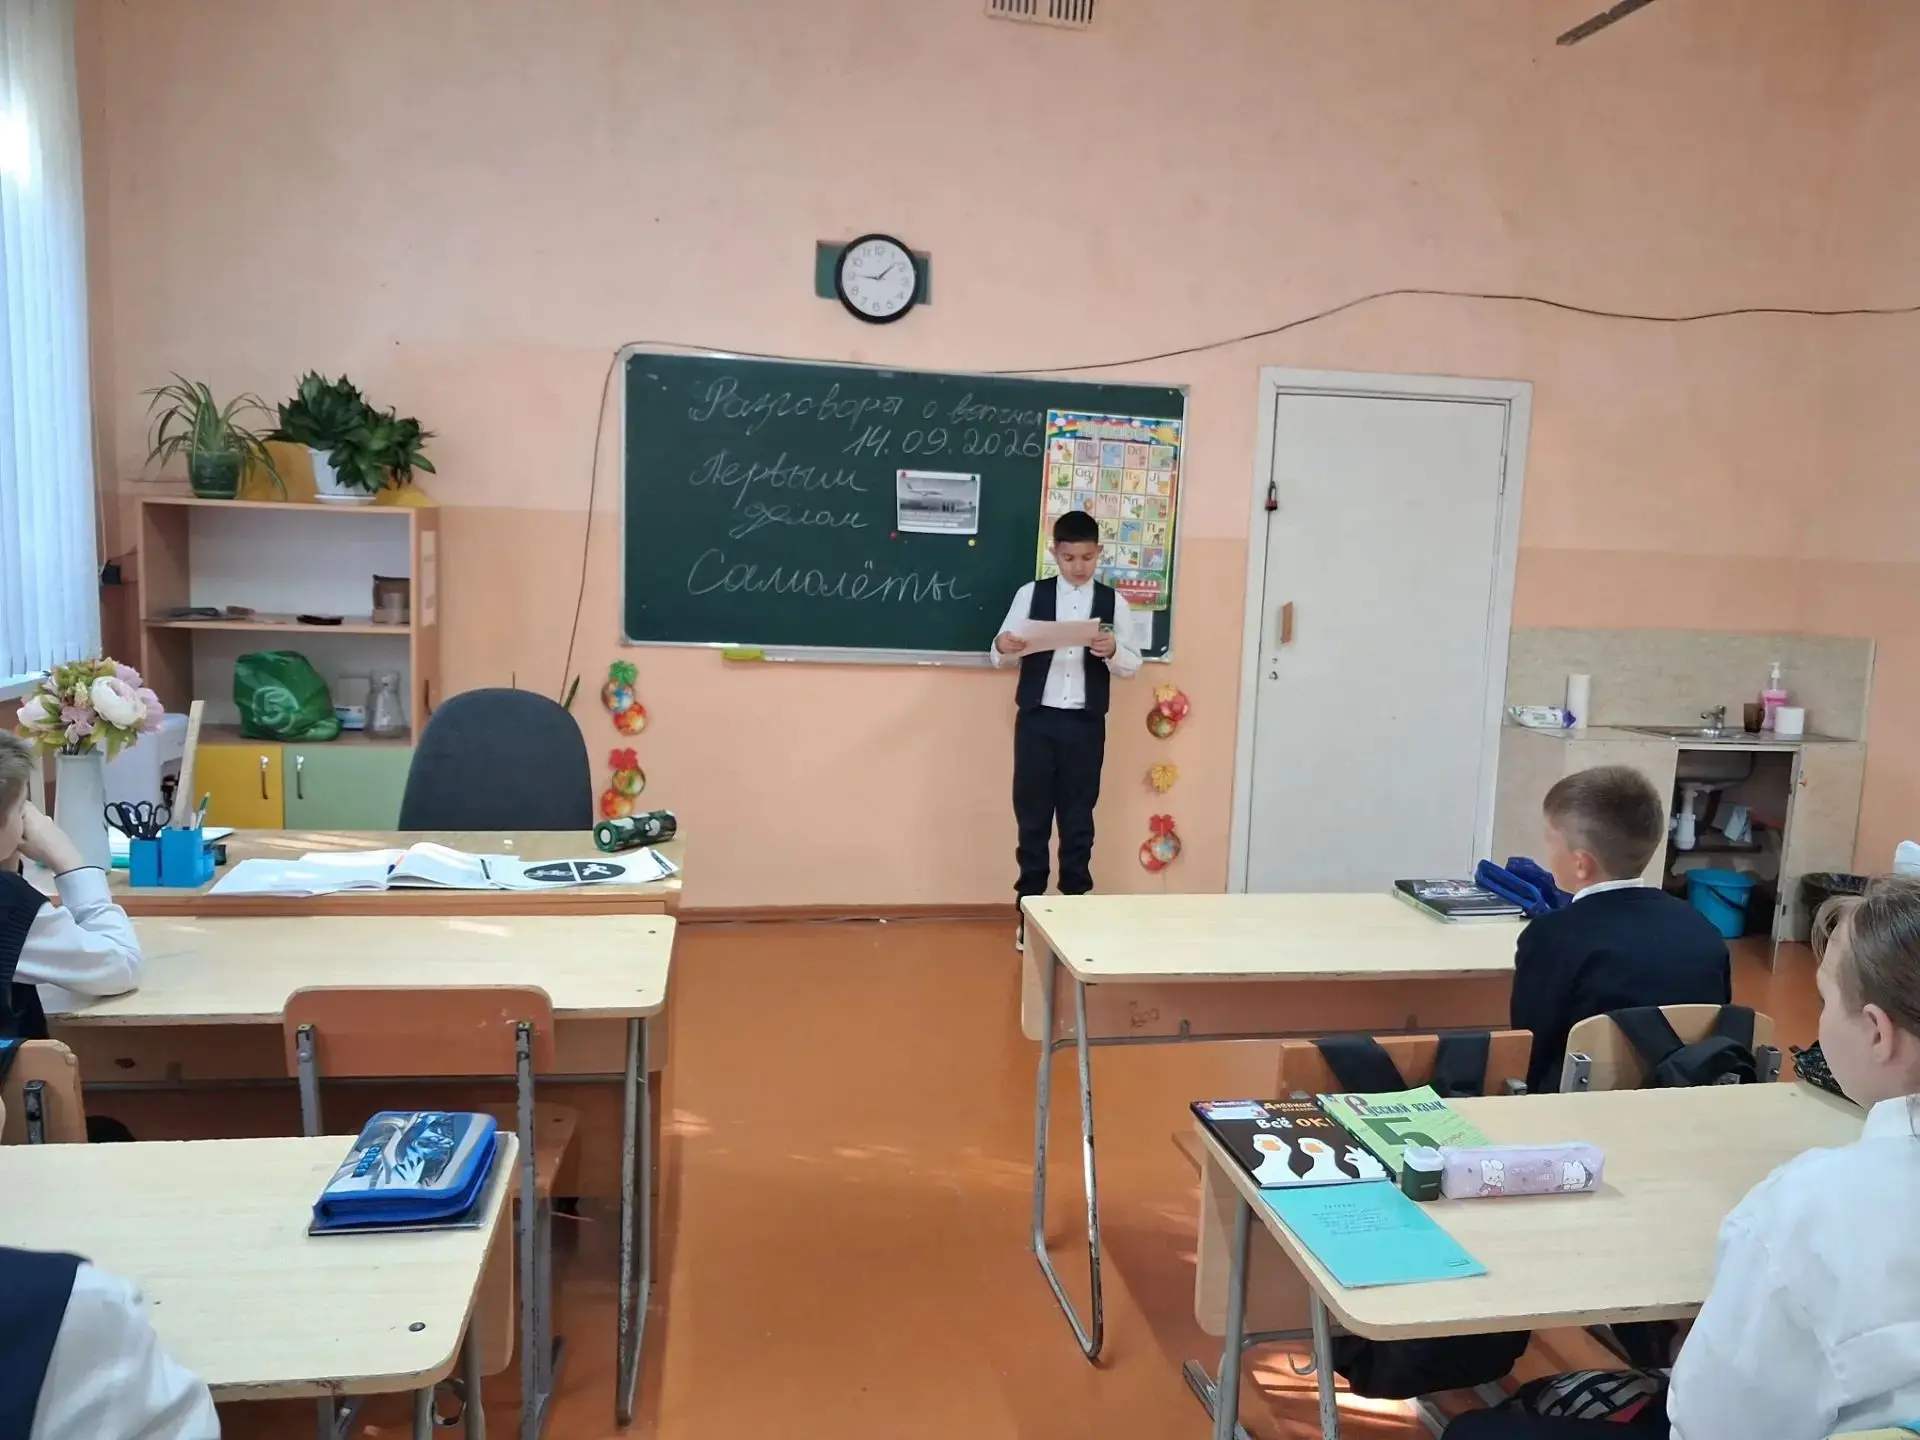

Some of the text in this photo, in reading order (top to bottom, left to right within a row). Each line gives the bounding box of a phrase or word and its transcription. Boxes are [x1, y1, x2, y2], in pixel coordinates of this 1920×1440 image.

[922, 402, 938, 419] о
[842, 425, 1042, 457] 14.09.2026
[690, 449, 869, 509] Первым
[687, 548, 972, 602] Самолёты
[1344, 1095, 1448, 1117] Русский язык
[1256, 1117, 1293, 1129] Всё
[1361, 1117, 1441, 1158] 5
